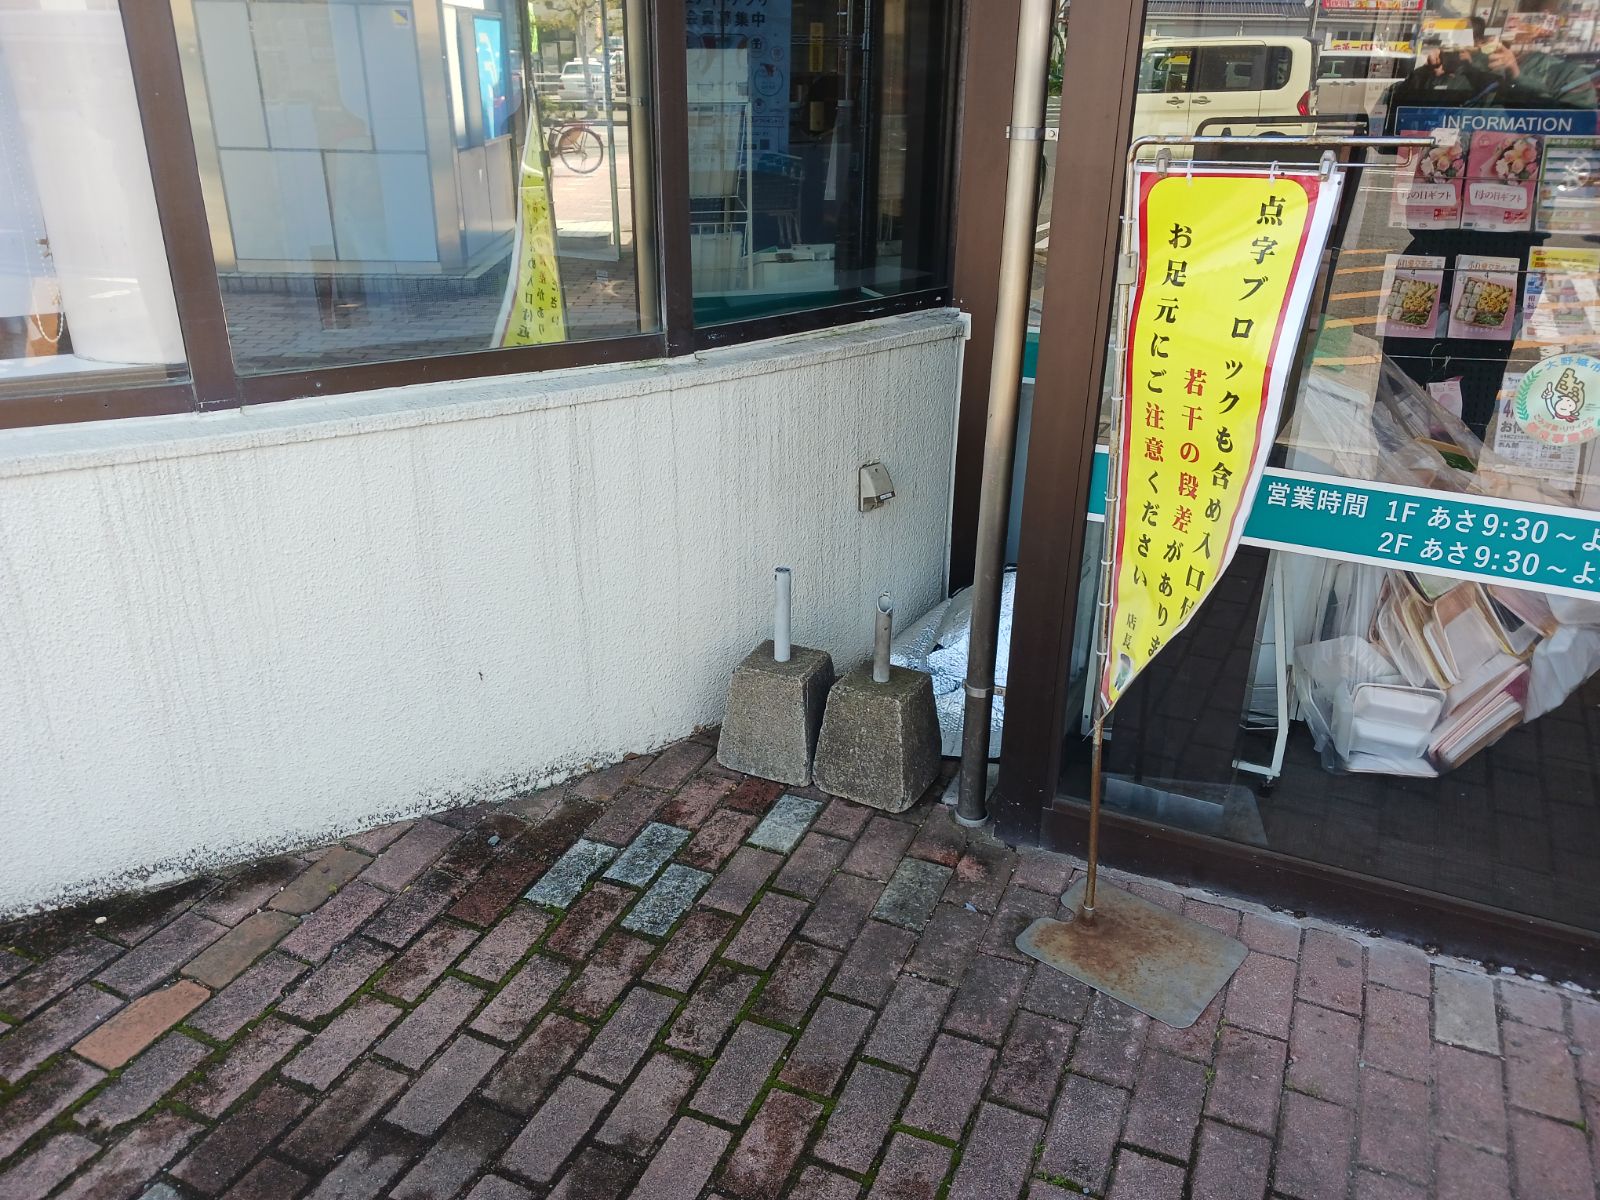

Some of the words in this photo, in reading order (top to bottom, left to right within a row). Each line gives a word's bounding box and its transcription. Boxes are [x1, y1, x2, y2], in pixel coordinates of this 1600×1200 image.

[1442, 114, 1573, 134] INFORMATION
[1474, 189, 1524, 204] 母の日ギフト
[1133, 222, 1193, 588] お足元にご注意ください
[1266, 481, 1370, 519] 営業時間
[1385, 499, 1421, 524] 1F
[1377, 531, 1414, 555] 2F
